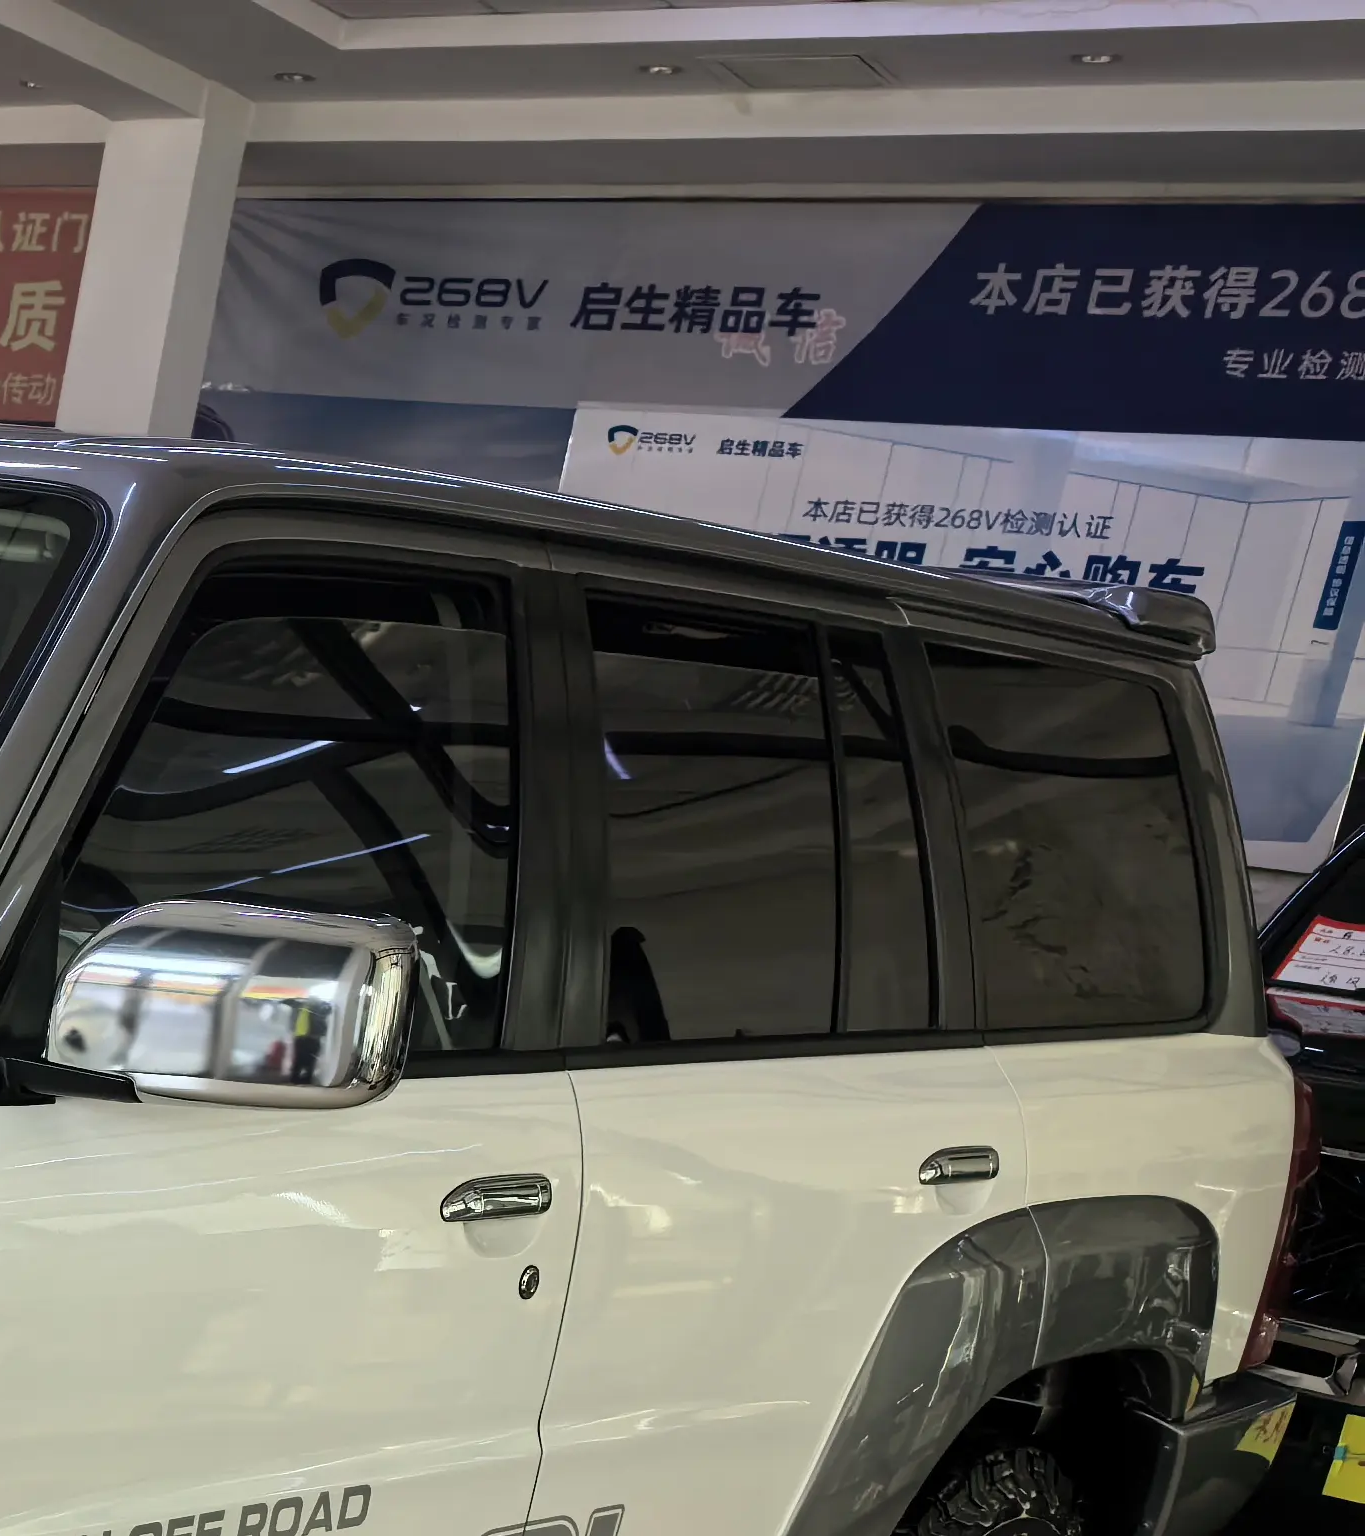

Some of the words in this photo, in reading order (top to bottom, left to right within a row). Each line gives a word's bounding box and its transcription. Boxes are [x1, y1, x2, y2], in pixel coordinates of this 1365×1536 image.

[399, 276, 550, 309] 268V
[570, 282, 822, 337] 启生精品车
[637, 431, 697, 446] 268V
[716, 438, 805, 459] 启生精品车
[801, 497, 1115, 541] 本店已获得268V检测认证
